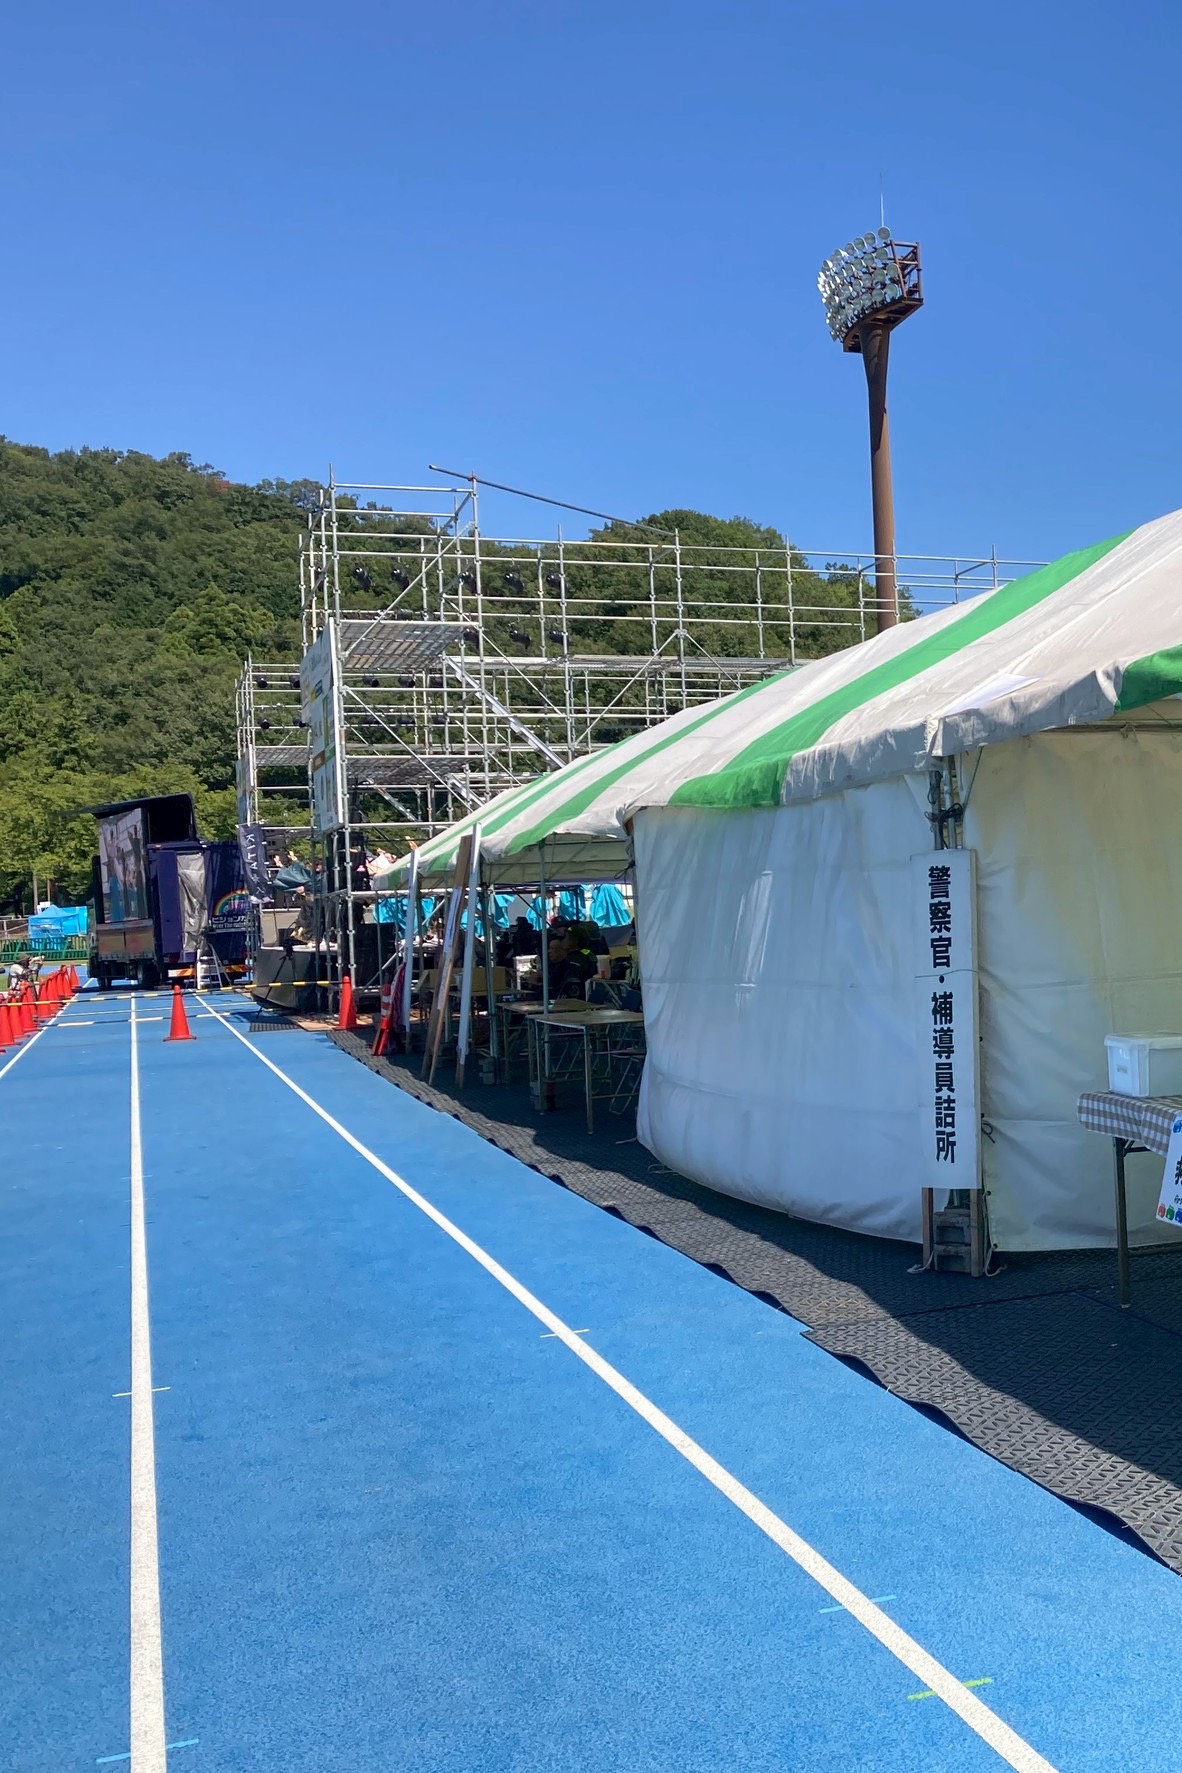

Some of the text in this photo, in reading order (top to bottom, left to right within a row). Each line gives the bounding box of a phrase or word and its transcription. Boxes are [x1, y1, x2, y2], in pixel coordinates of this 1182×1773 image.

[927, 865, 957, 1164] 警察官・補導員詰所
